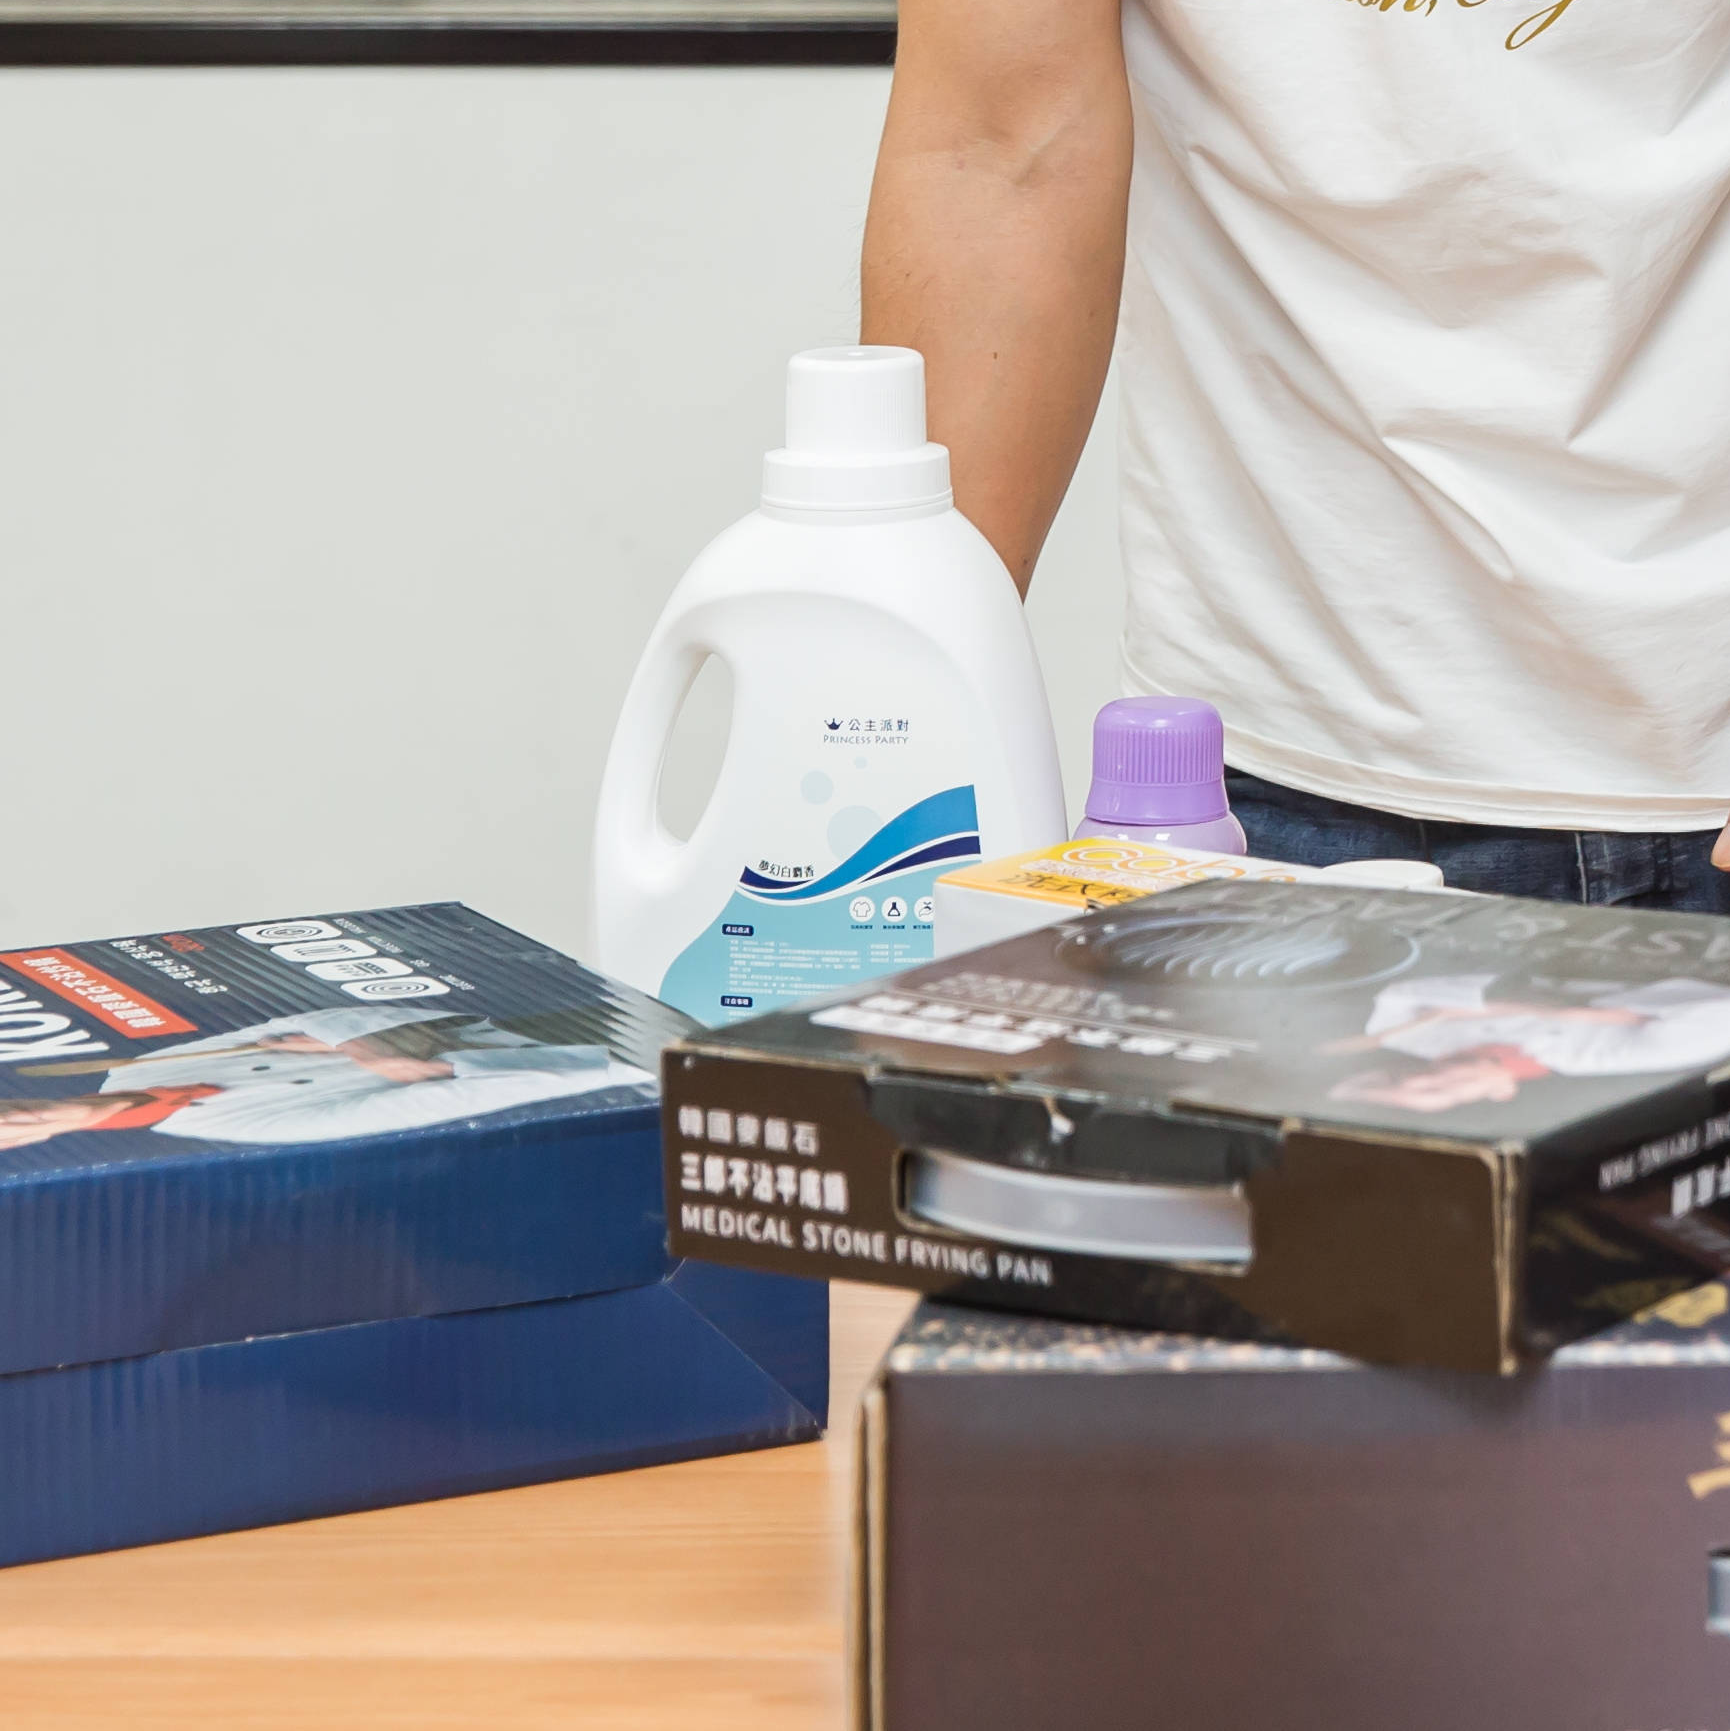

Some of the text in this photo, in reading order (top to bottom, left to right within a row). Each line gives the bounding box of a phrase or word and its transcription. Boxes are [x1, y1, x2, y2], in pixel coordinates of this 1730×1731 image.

[848, 718, 909, 732] 公主派對
[680, 1203, 1053, 1287] MEDICAL STONE FRYING PAN
